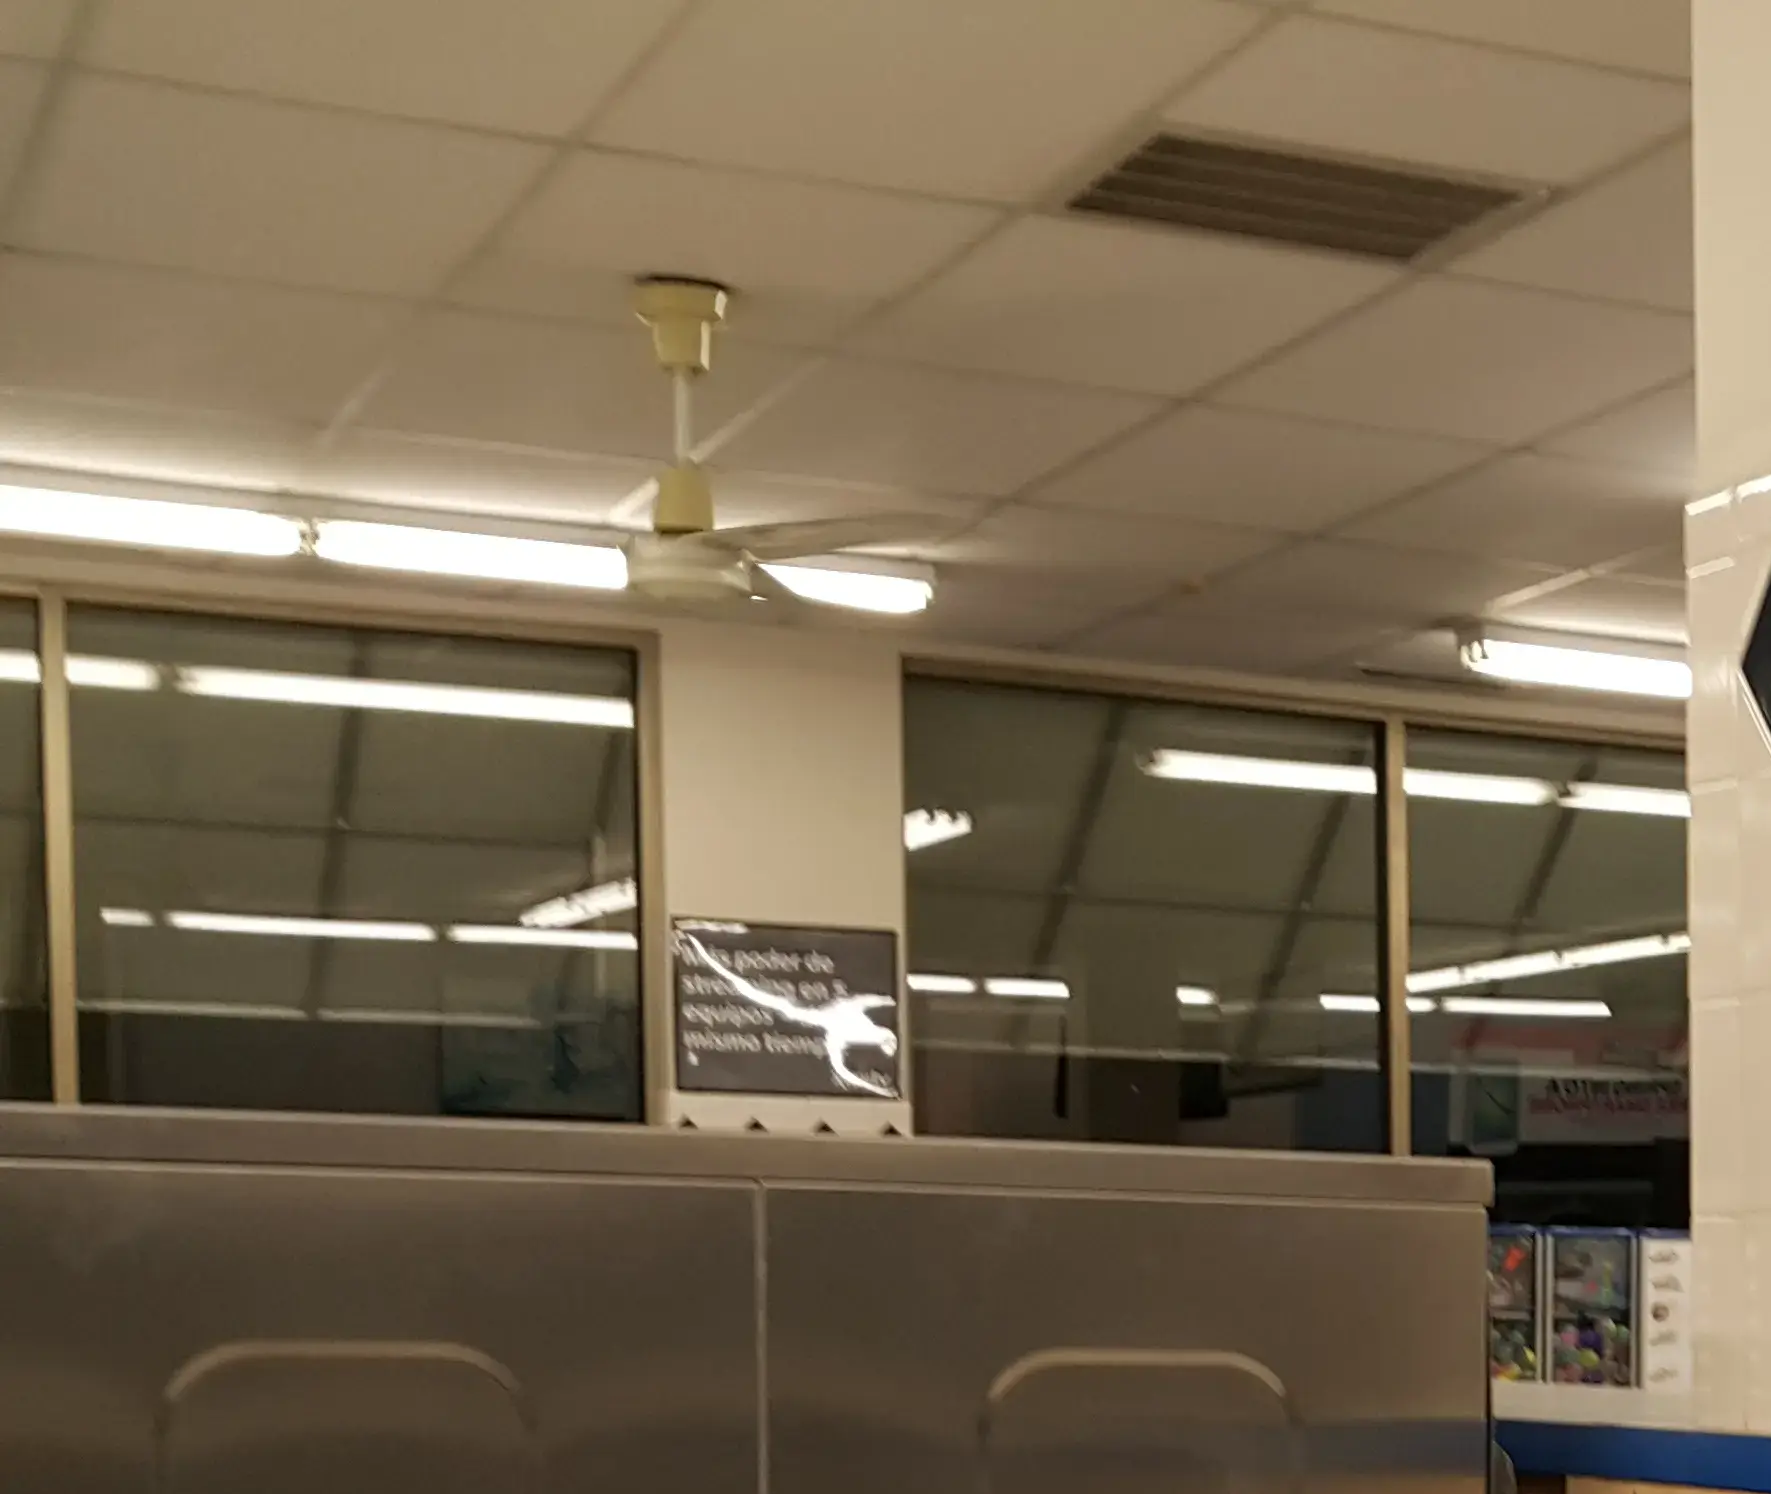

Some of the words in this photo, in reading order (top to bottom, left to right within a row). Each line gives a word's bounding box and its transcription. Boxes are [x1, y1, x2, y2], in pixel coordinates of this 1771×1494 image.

[734, 947, 801, 974] poder
[803, 949, 836, 975] de
[682, 1027, 763, 1053] mismo
